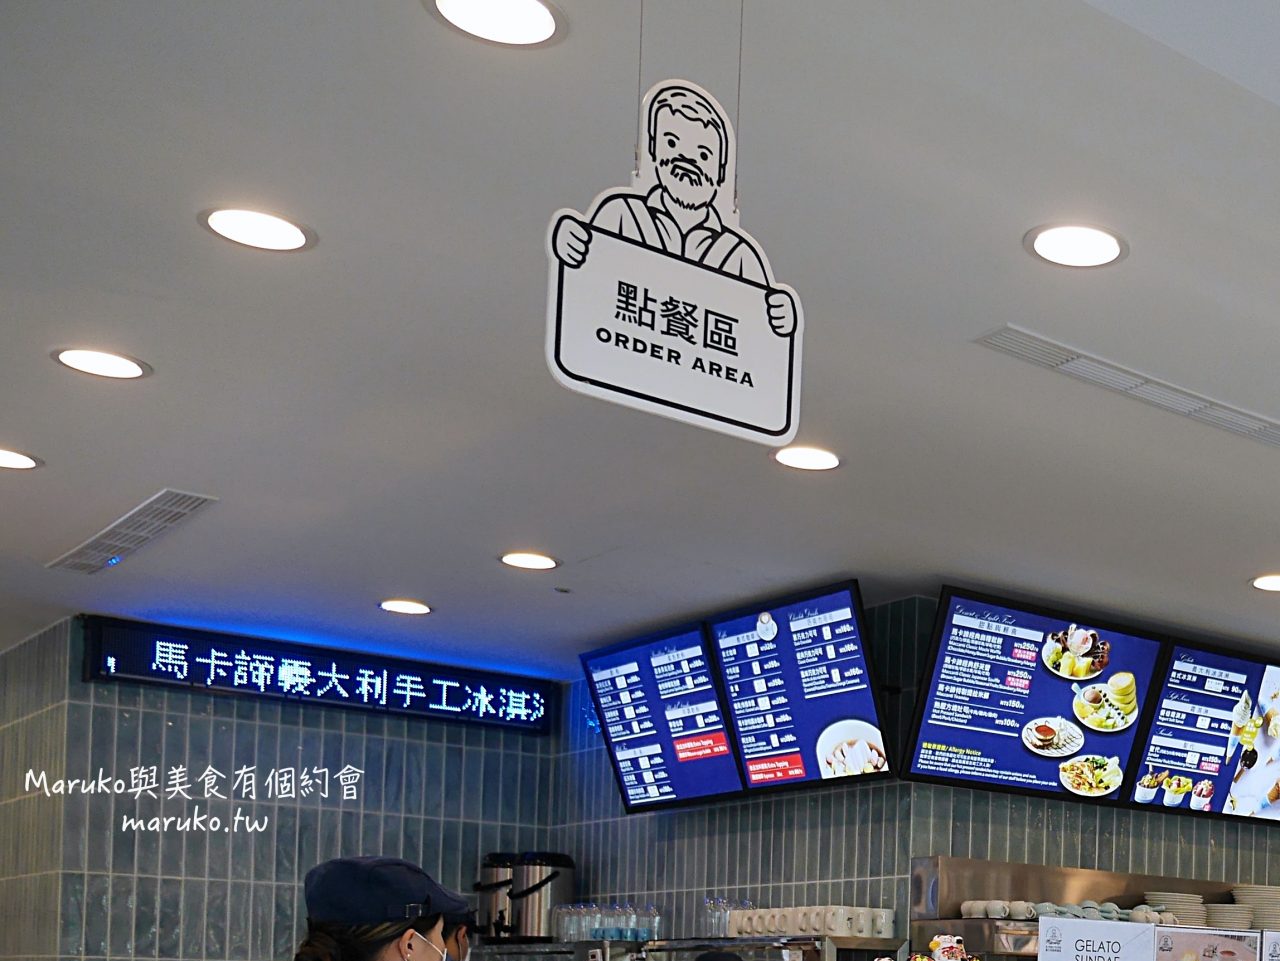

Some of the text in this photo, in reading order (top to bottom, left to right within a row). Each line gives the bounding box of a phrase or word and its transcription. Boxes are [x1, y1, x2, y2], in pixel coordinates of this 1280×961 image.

[614, 280, 739, 357] 點餐區
[596, 327, 755, 388] ORDER AREA
[1074, 939, 1121, 953] GELATO
